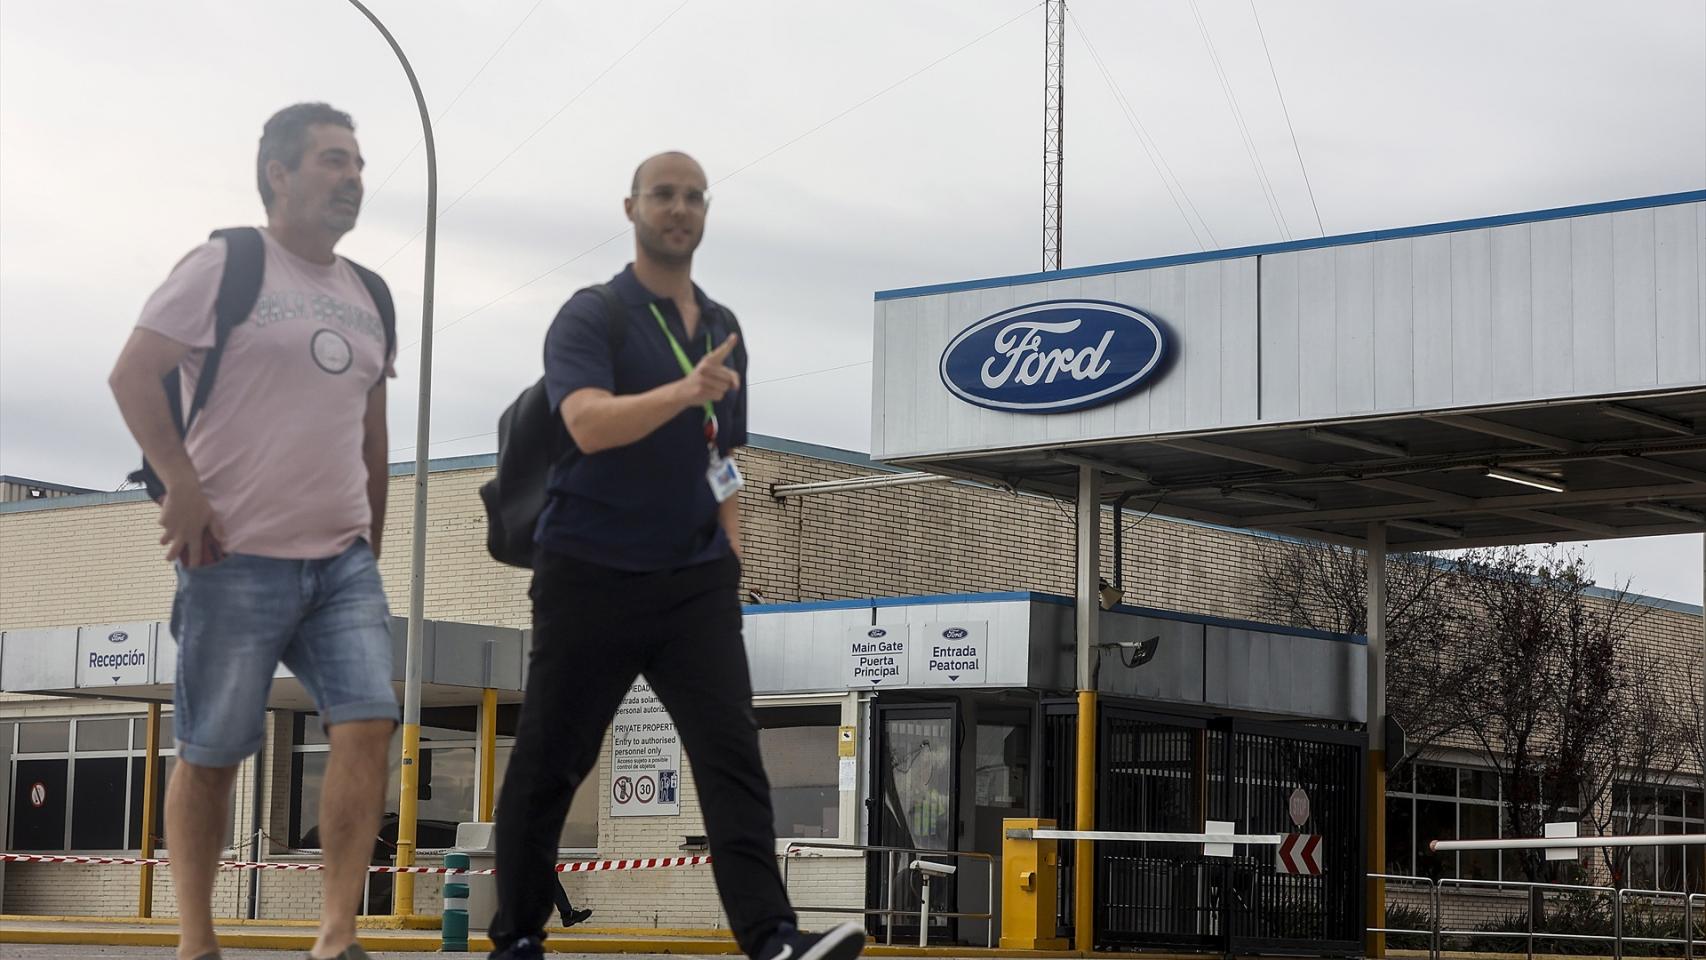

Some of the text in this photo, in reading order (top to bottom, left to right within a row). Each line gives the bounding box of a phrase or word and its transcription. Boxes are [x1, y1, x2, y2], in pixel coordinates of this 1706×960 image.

[980, 318, 1115, 389] Ford
[852, 641, 903, 653] Main Gate
[932, 645, 976, 657] Entrada
[89, 648, 145, 670] Recepción
[860, 656, 894, 666] Puerta
[929, 658, 979, 671] Peatonal
[854, 665, 899, 678] Principal
[641, 695, 660, 703] solam
[615, 706, 642, 716] personal
[615, 725, 641, 733] PRIVATE
[615, 736, 676, 747] Entry to authorised
[615, 746, 661, 756] personnel only
[640, 784, 651, 795] 30
